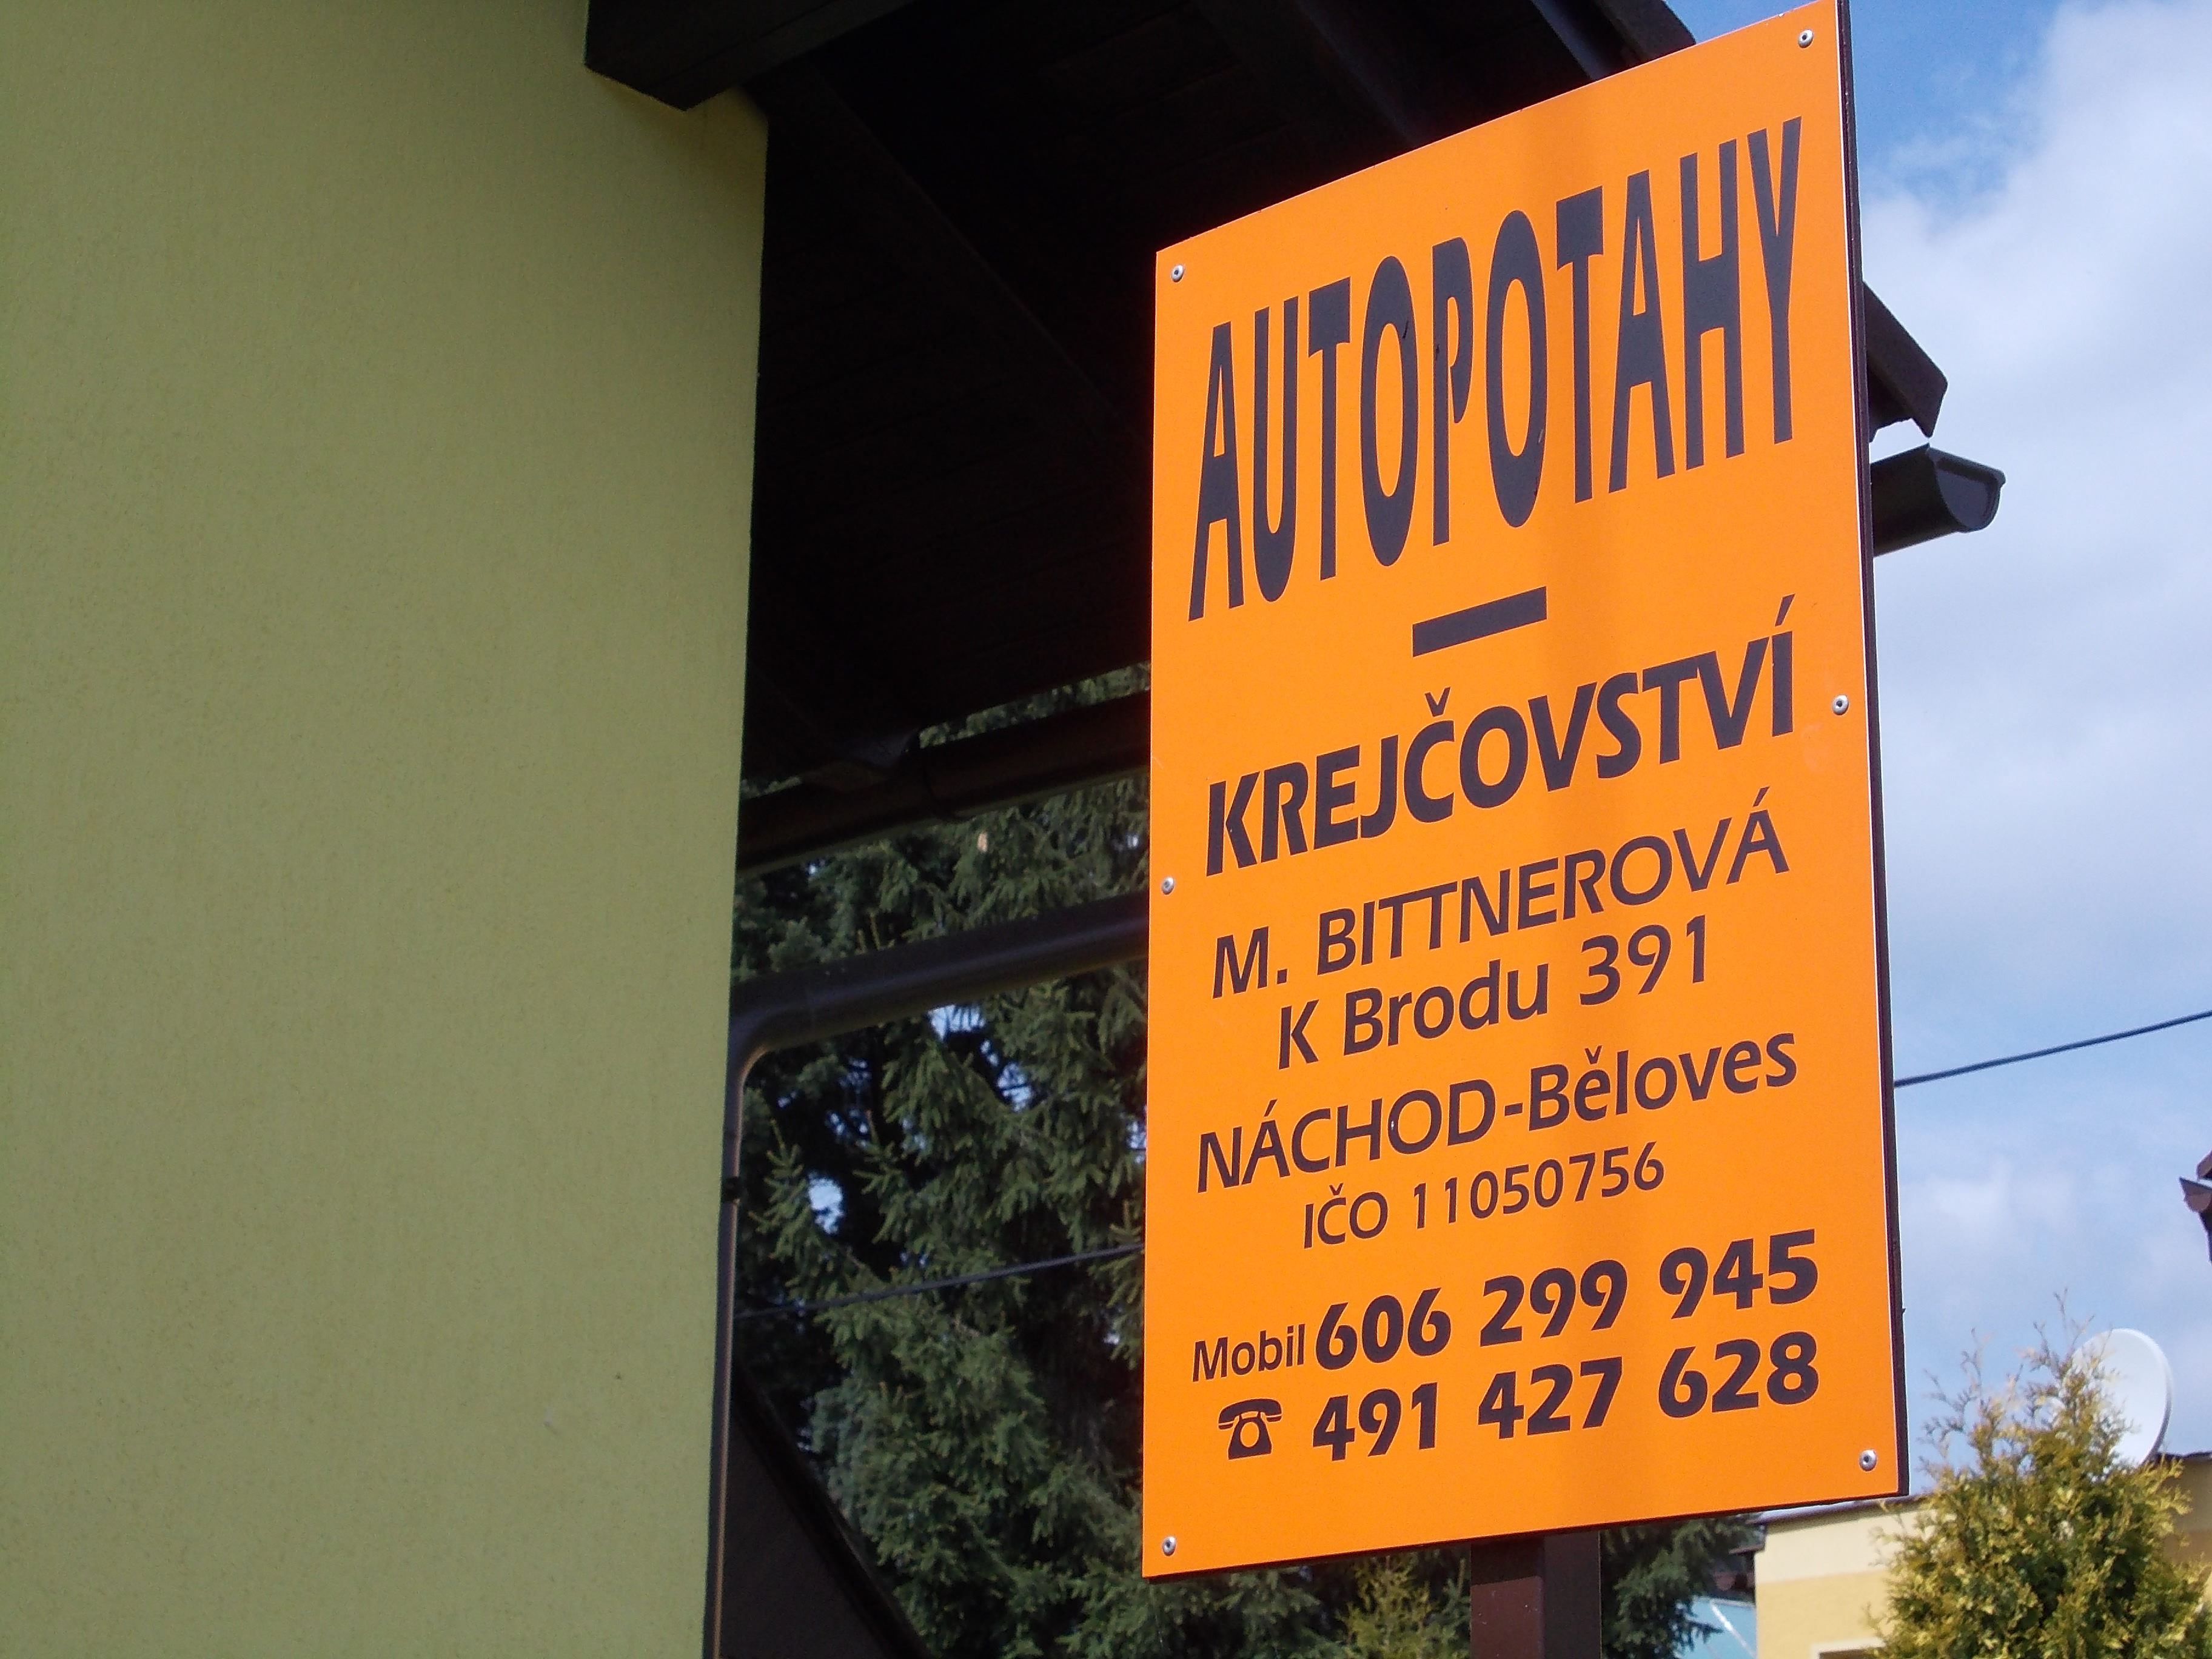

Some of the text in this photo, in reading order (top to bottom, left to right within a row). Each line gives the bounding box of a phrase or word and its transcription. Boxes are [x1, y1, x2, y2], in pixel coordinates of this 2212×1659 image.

[1188, 116, 1803, 620] AUTOPOTAHY
[1206, 593, 1794, 876] KREJČOVSTVÍ
[1213, 785, 1789, 999] M. BITTNEROVÁ
[1279, 915, 1705, 1068] K Brodu 391
[1198, 1033, 1797, 1193] NÁCHOD-Běloves
[1303, 1142, 1664, 1249] IČO 11050756
[1192, 1228, 1818, 1381] Mobil 606 299 945
[1312, 1330, 1819, 1461] 491 427 628
